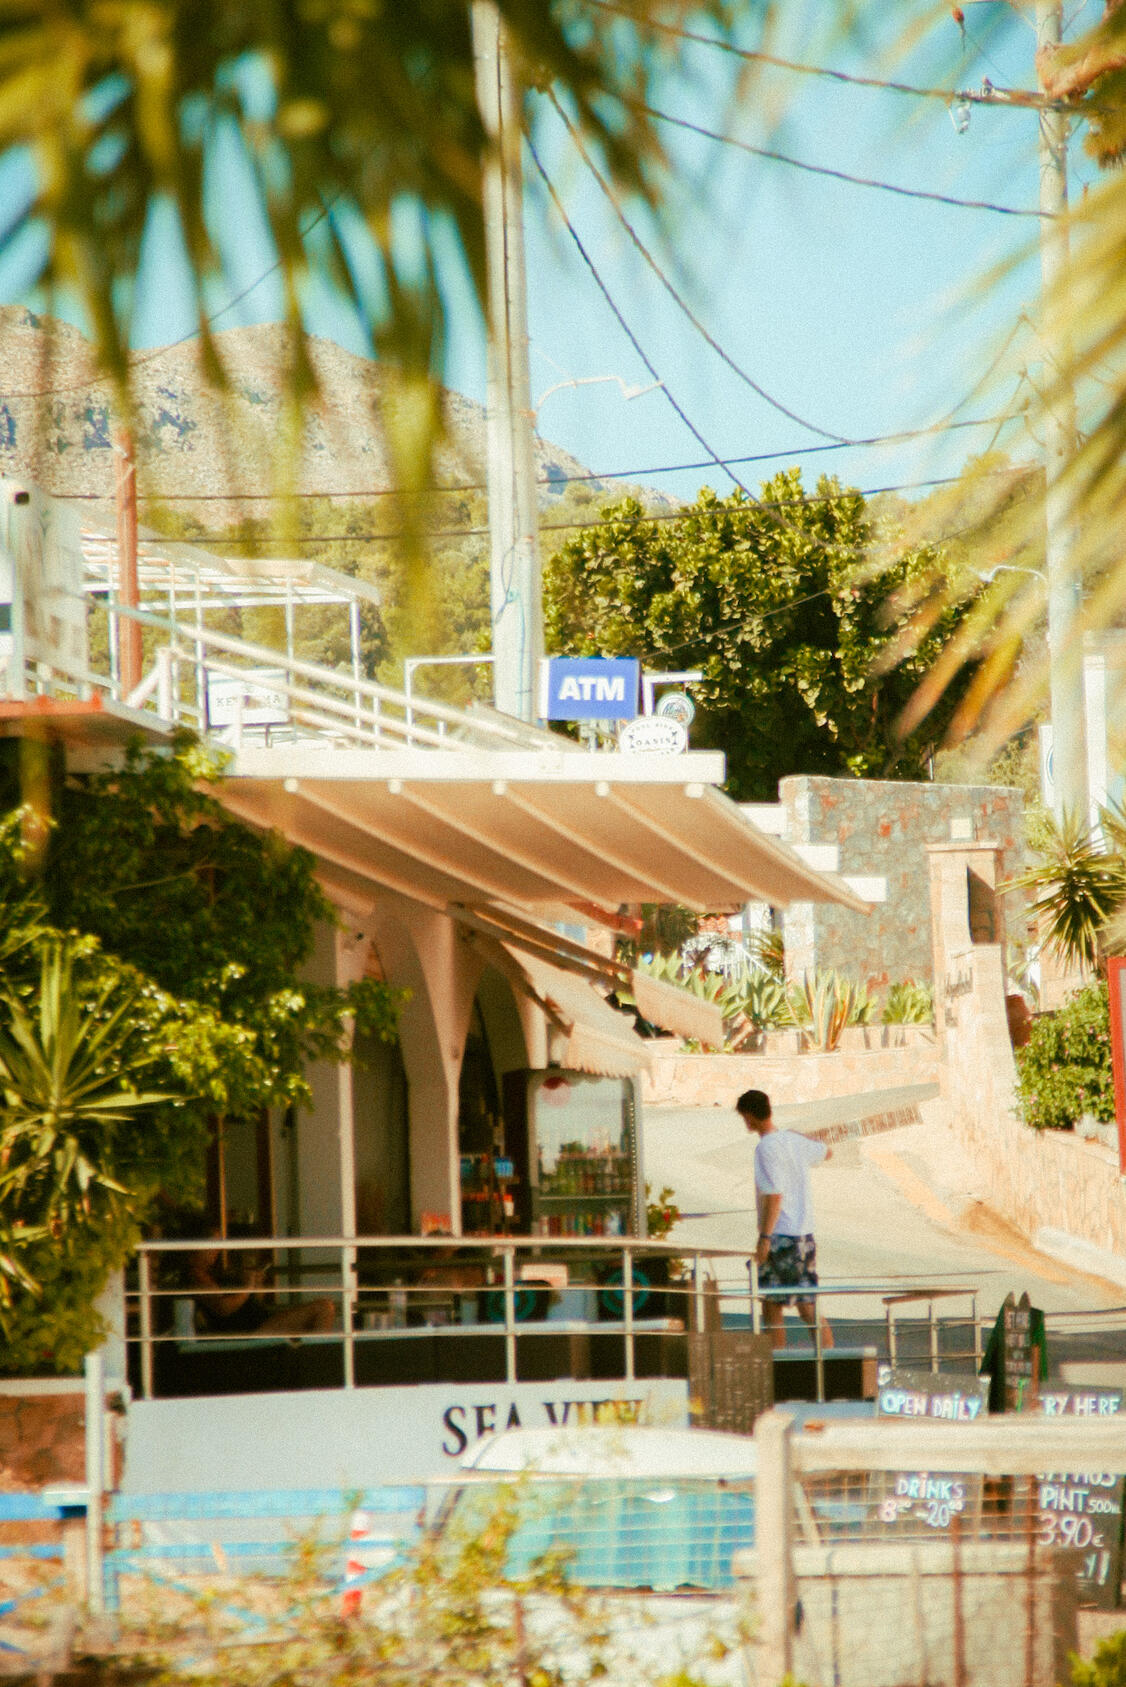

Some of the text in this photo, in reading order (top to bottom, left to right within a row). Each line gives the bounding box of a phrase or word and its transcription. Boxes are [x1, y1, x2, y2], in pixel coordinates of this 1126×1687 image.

[559, 677, 625, 701] ATM
[636, 736, 671, 746] OASIS
[881, 1391, 928, 1415] OPEN
[1074, 1393, 1121, 1416] HERE
